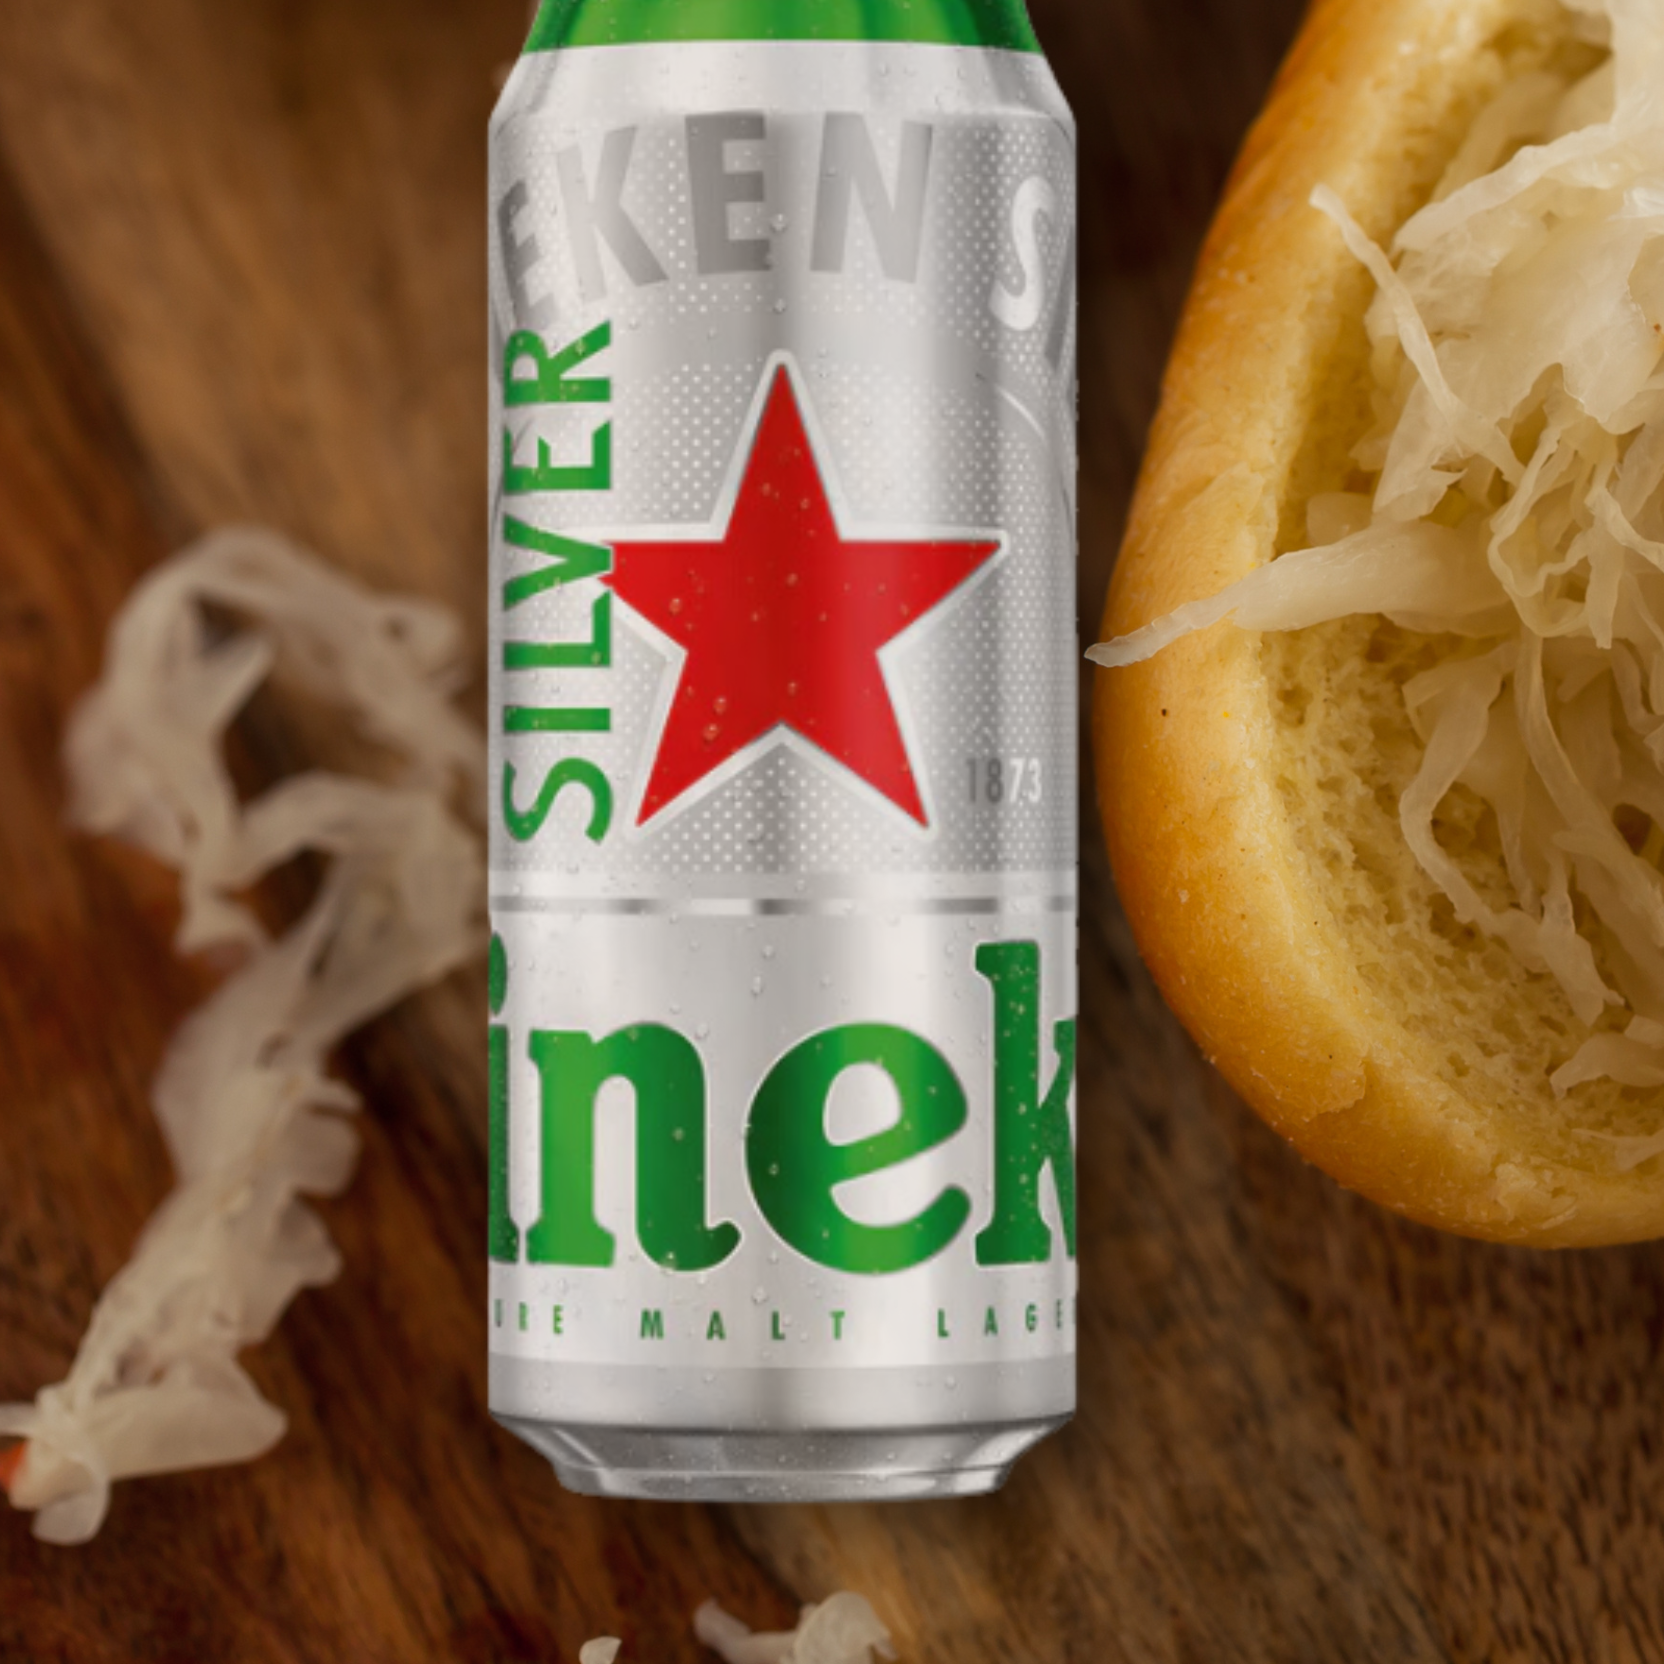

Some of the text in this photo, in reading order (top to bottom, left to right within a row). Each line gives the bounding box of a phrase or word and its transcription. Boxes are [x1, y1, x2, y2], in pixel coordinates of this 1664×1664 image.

[502, 320, 614, 844] SILVER
[965, 756, 1043, 805] 1873
[640, 1308, 847, 1341] MALT
[937, 1297, 1077, 1338] LAGE
